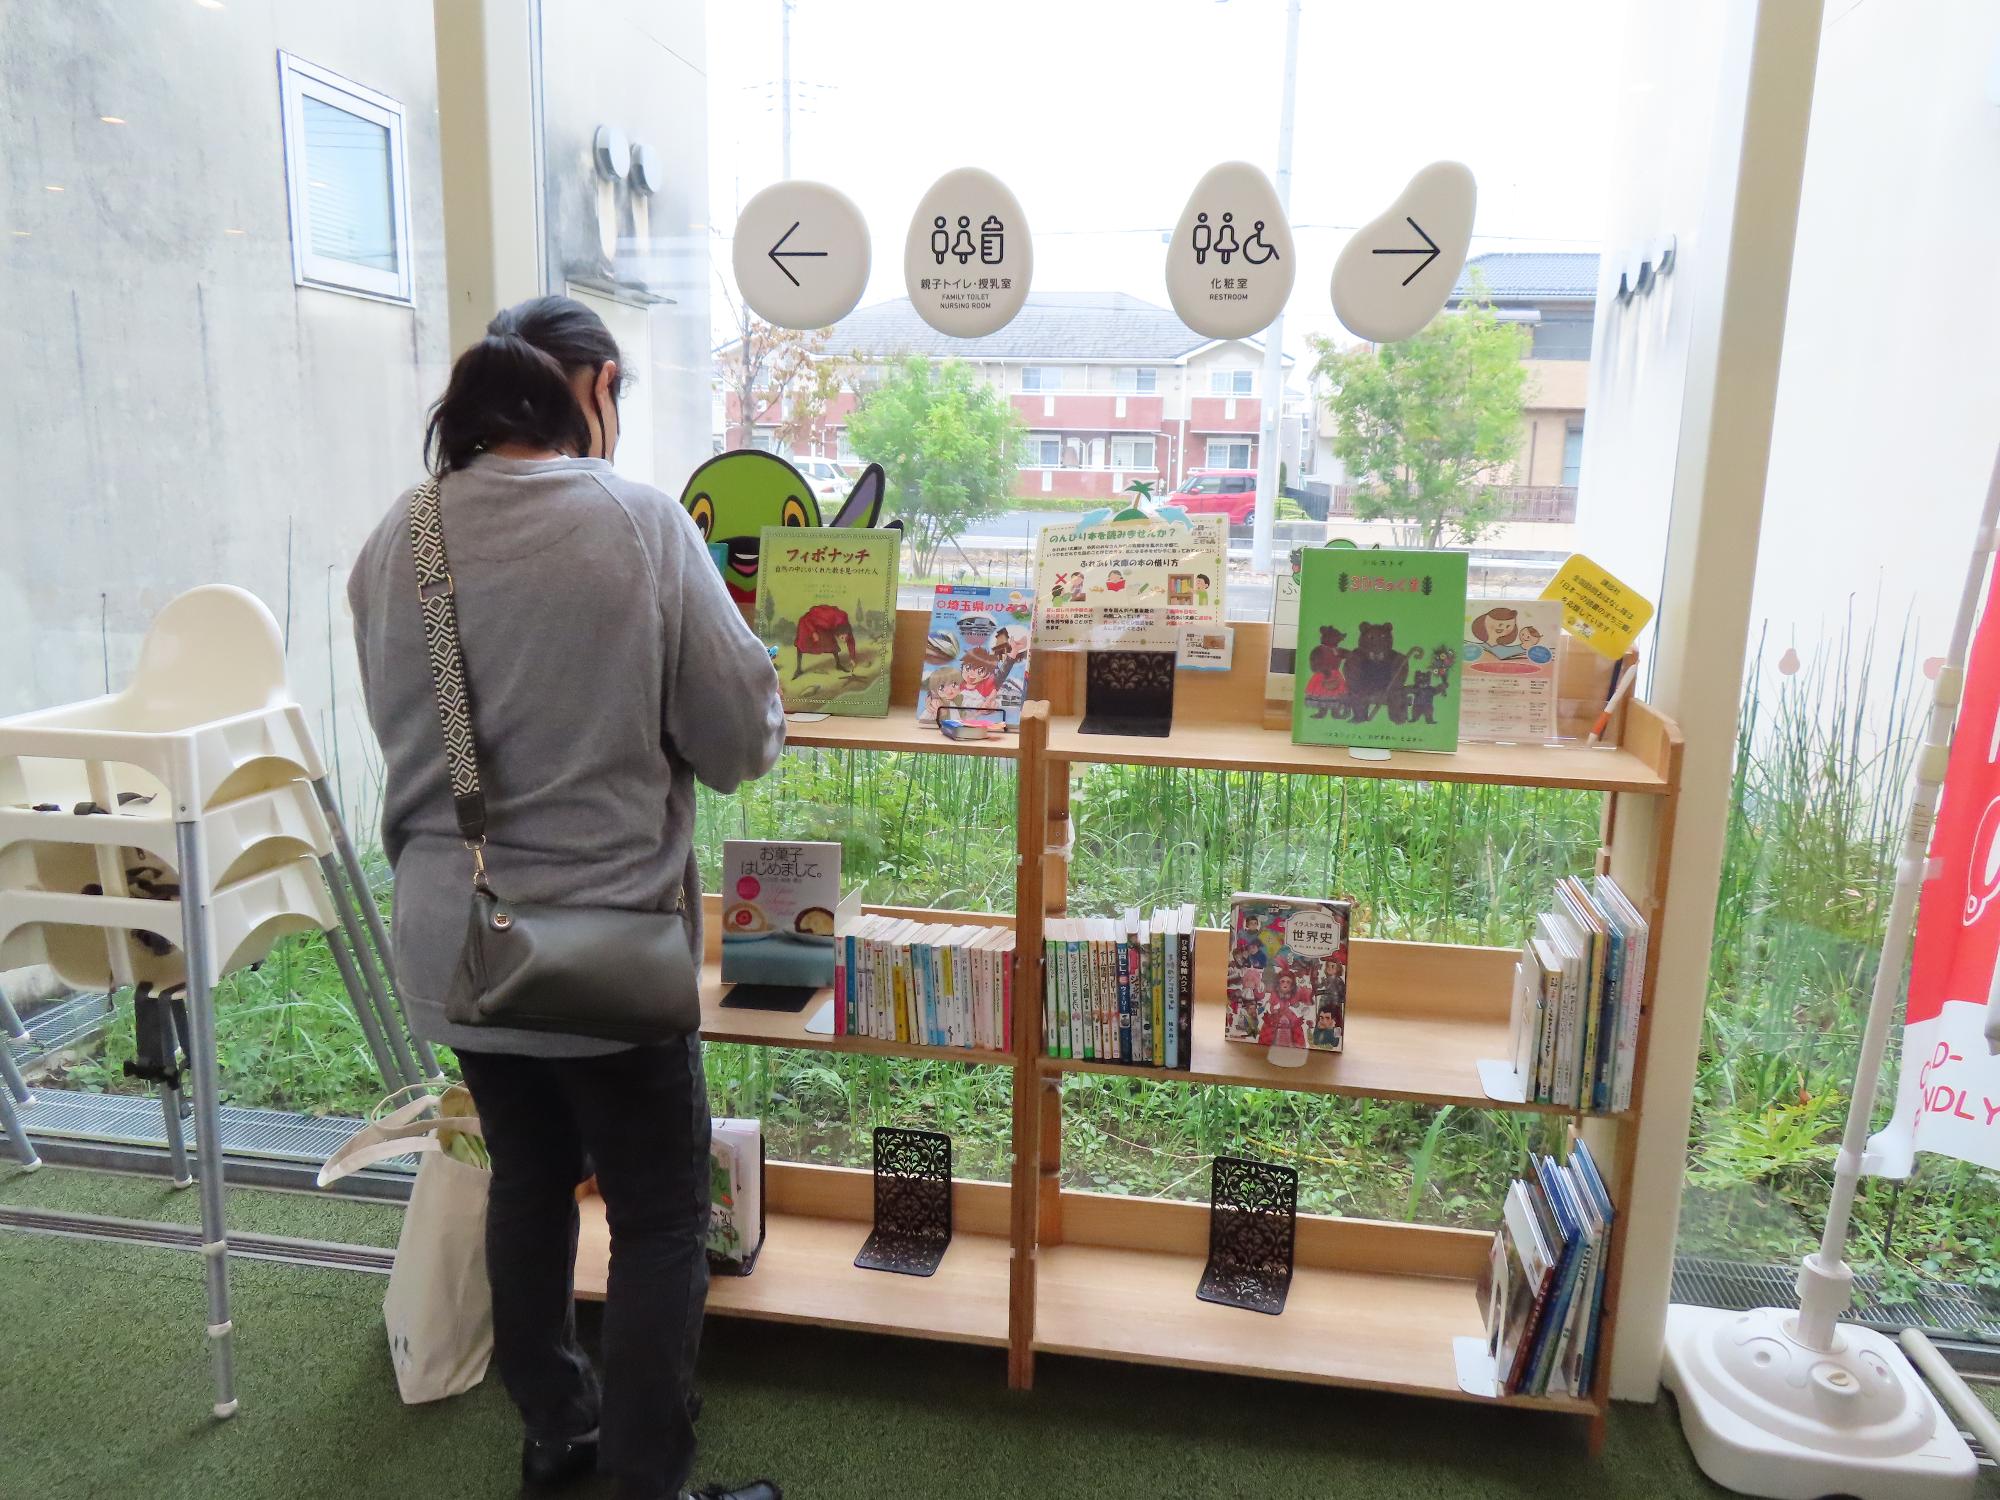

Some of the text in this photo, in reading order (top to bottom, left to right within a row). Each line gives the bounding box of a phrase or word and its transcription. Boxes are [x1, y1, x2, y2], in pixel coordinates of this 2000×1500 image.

[920, 278, 1012, 290] 親子トイレ・授乳室
[1210, 277, 1248, 290] 化粧室
[941, 293, 989, 301] FAMILY TOILET
[1209, 293, 1248, 301] RESTROOM
[786, 546, 870, 565] フィボナッチ
[947, 599, 1028, 613] 埼玉県のひみつ
[760, 846, 804, 863] お菓子
[741, 861, 823, 879] はじめまして。
[1292, 929, 1333, 945] 世界史
